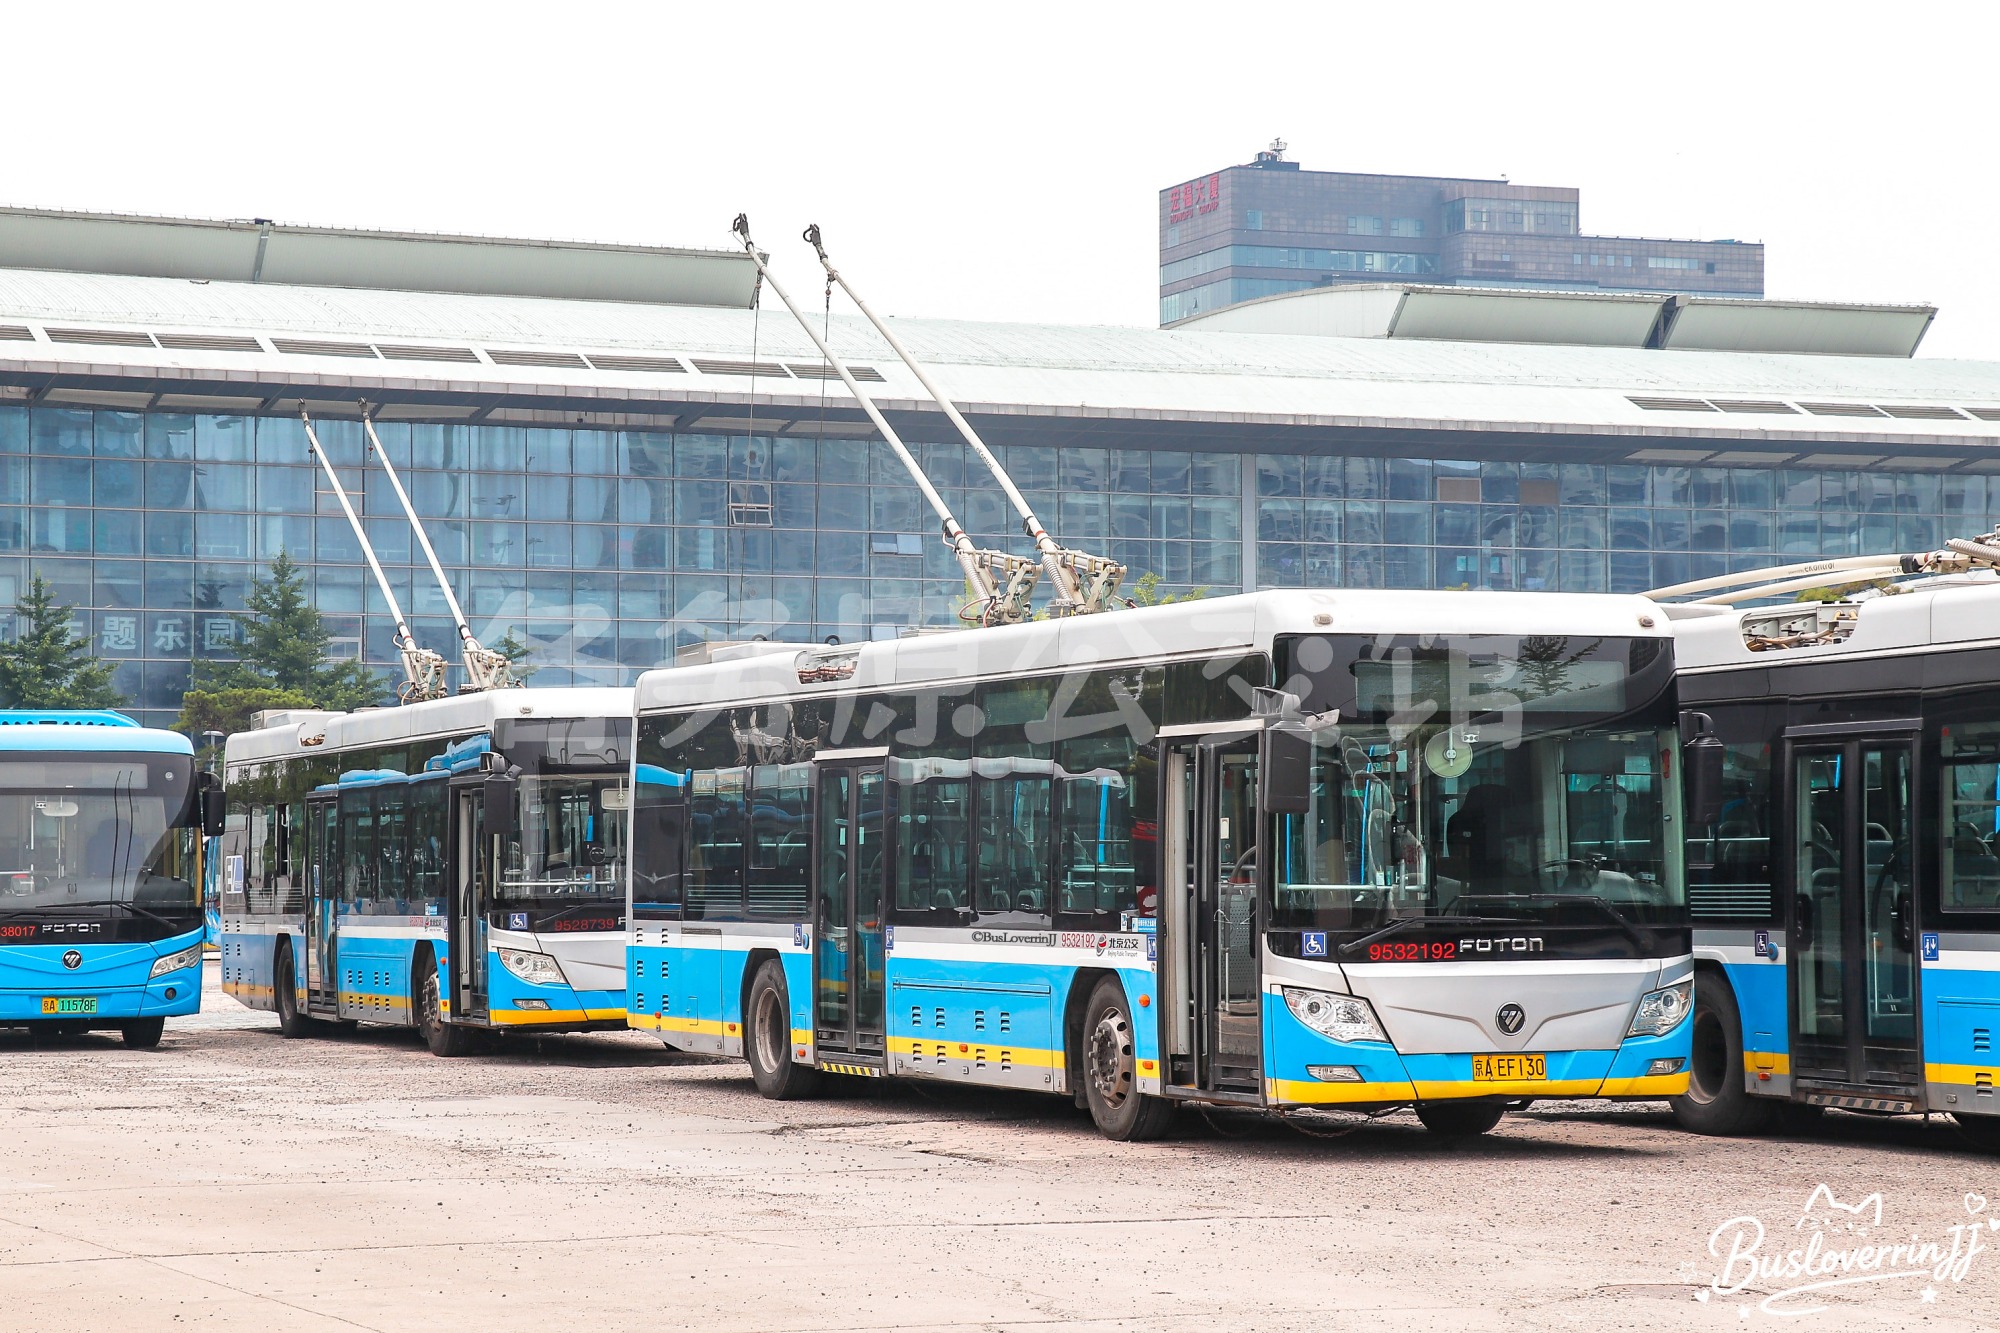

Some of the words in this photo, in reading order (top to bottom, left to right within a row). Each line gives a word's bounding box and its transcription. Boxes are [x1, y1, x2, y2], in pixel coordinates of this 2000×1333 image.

[1169, 173, 1220, 212] 宏福大厦
[0, 925, 36, 937] 38017
[42, 923, 101, 933] FOTON
[554, 918, 615, 931] 9528739
[1061, 933, 1096, 948] 9532192
[1108, 938, 1139, 949] 北京公交
[1459, 937, 1544, 953] FOTON
[1369, 942, 1455, 961] 9532192
